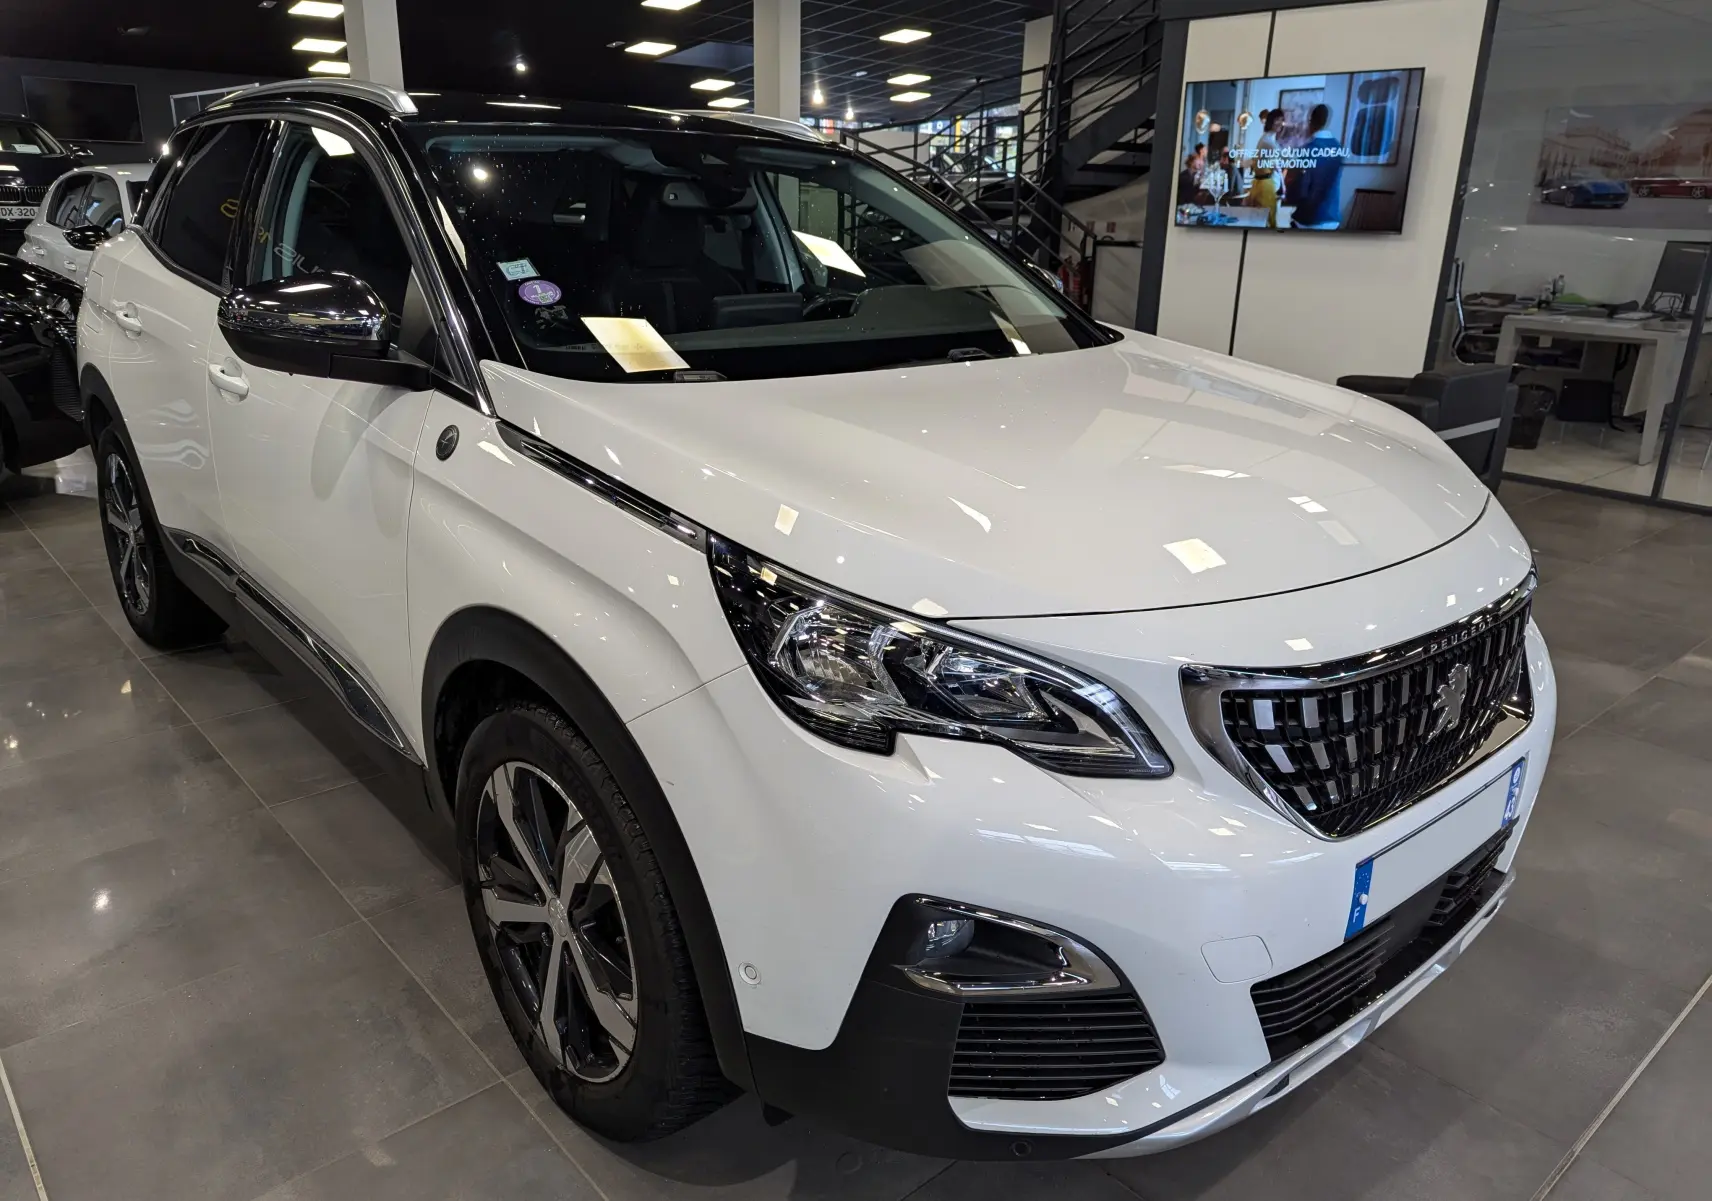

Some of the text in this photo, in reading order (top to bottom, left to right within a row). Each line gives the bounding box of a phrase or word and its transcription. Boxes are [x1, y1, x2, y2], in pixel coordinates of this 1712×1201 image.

[1228, 147, 1350, 158] OFFREZ PLUS QU'UN CADEAU,
[1257, 159, 1275, 168] UNE
[1, 207, 36, 217] DX-320
[1430, 616, 1493, 654] PEUGEOT
[1352, 906, 1361, 923] F
